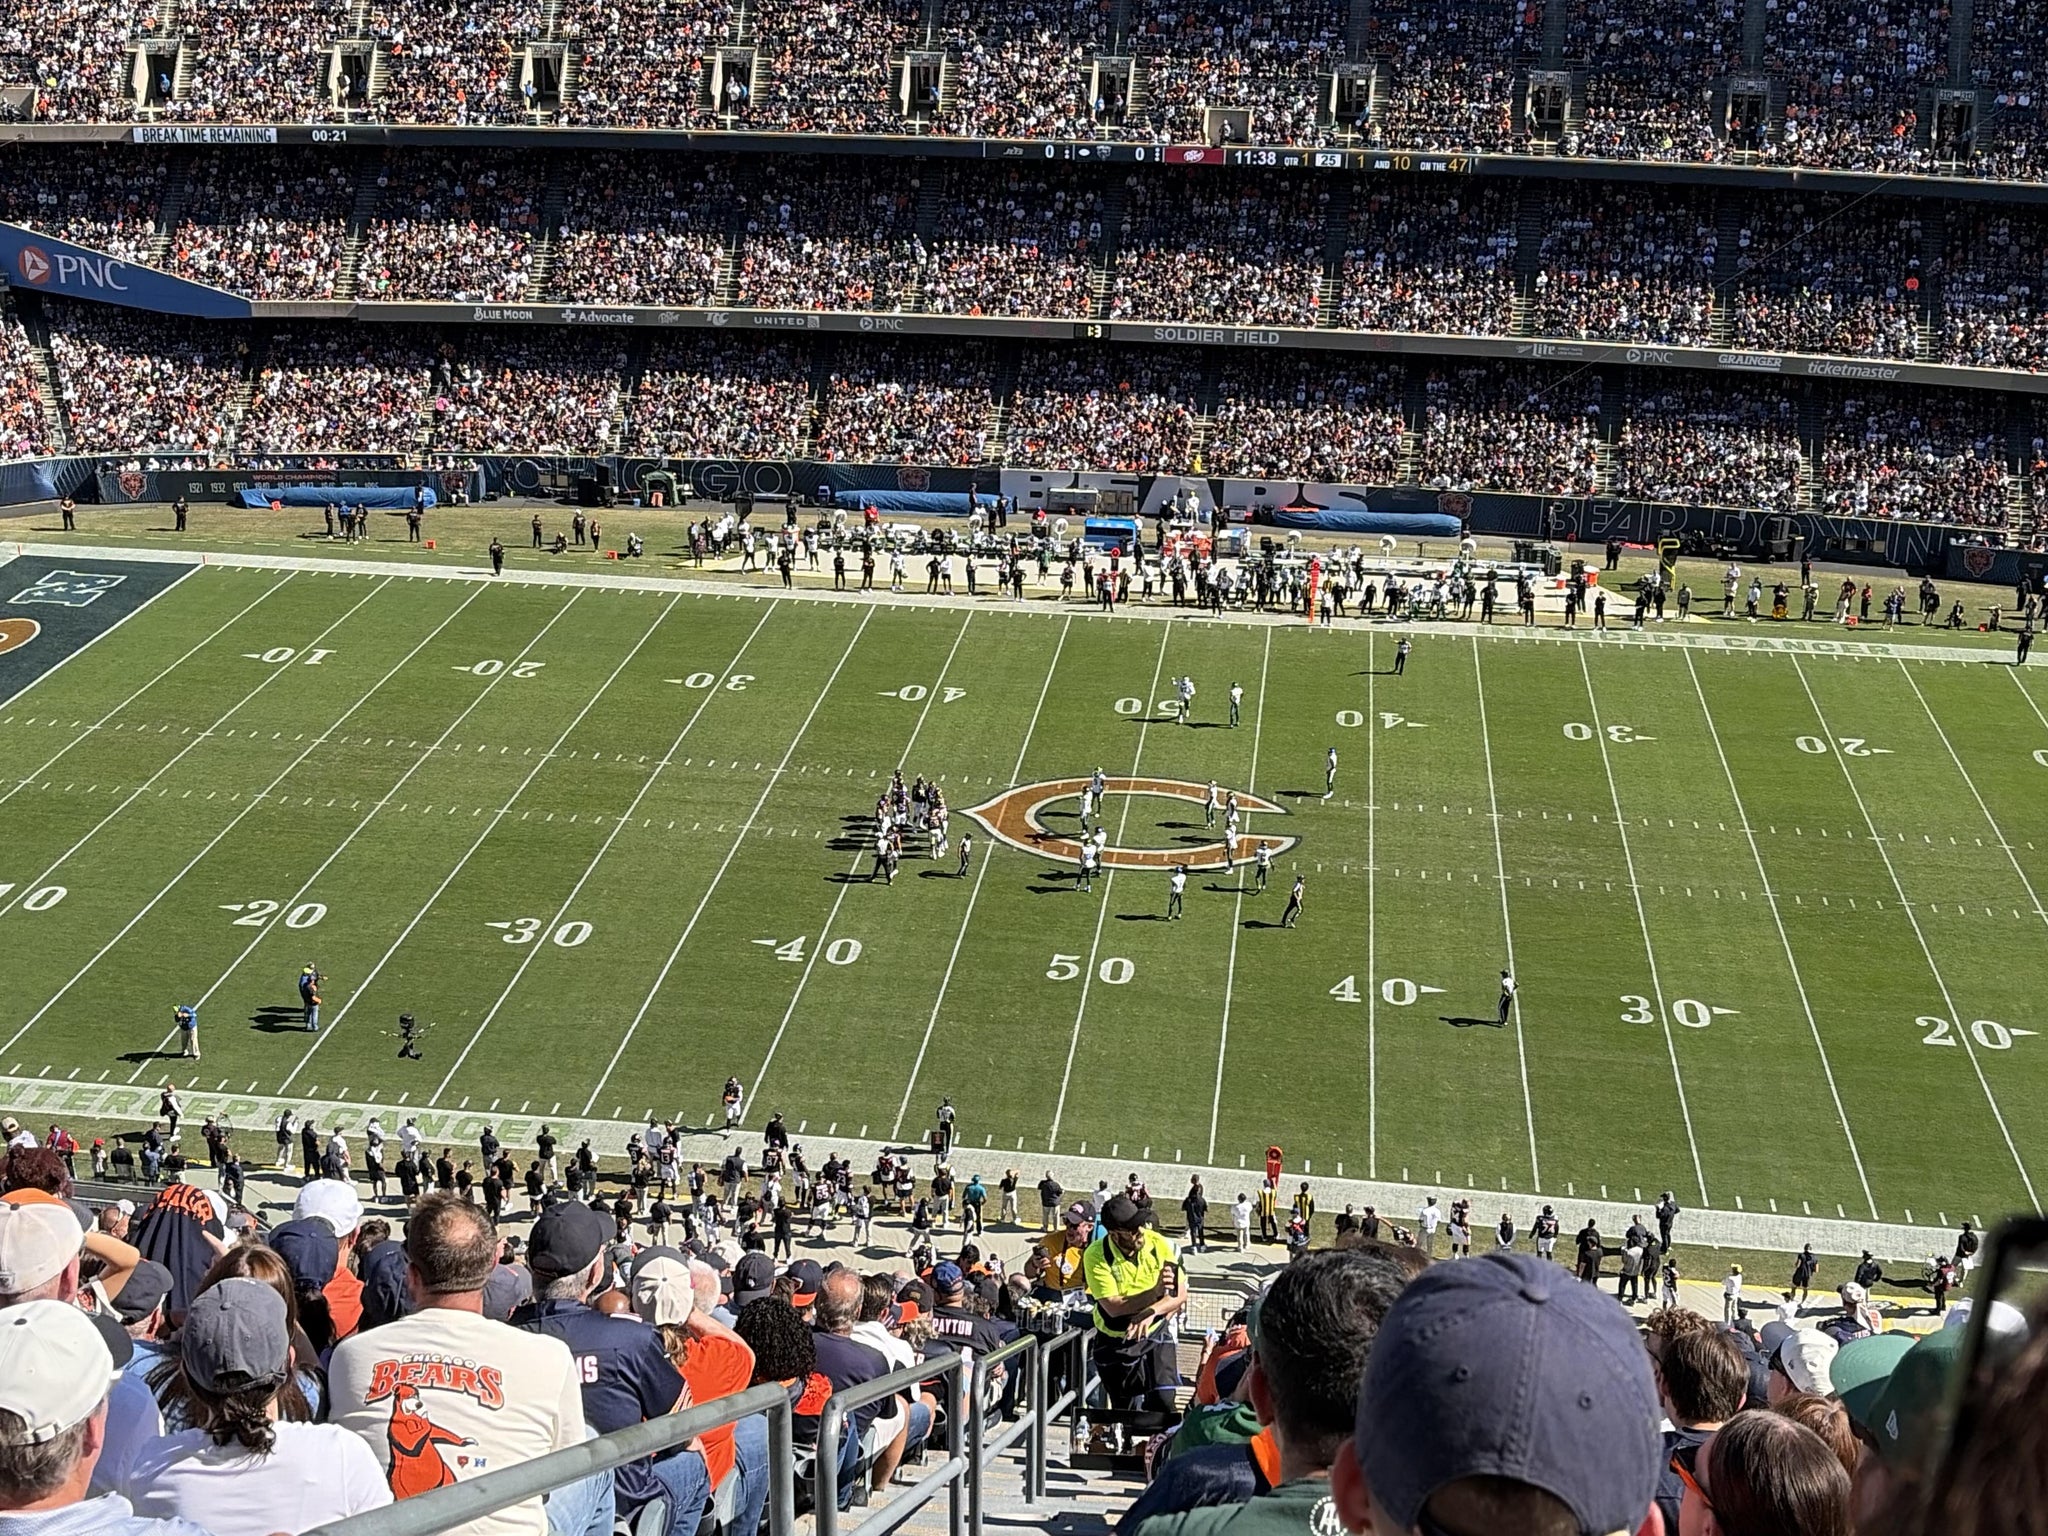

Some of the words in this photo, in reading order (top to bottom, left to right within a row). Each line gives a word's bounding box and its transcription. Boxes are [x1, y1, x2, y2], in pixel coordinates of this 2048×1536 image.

[142, 128, 178, 142] BREAK
[181, 128, 207, 142] TIME
[210, 128, 271, 142] REMAINING
[312, 130, 347, 142] 00:21
[1045, 145, 1054, 158] 0
[1136, 147, 1145, 160] 0
[1235, 150, 1276, 165] 11:38
[1284, 157, 1298, 167] QTR
[1301, 153, 1309, 166] 1
[1321, 155, 1337, 167] 25
[1357, 155, 1364, 168] 1
[1374, 160, 1390, 169] AND
[1393, 156, 1410, 170] 10
[1420, 161, 1430, 171] ON
[1431, 162, 1446, 172] THE
[1448, 158, 1469, 172] 47
[53, 254, 128, 291] PNC
[473, 307, 502, 321] BLUE
[503, 309, 533, 320] MOON
[578, 310, 635, 324] Advocate
[754, 316, 805, 326] UNITED
[875, 318, 904, 330] PNC
[1153, 327, 1224, 343] SOLDIER
[1234, 329, 1280, 345] FIELD
[1532, 344, 1556, 357] Lite
[1643, 351, 1673, 363] PNC
[1718, 354, 1782, 367] GRAINGER
[1807, 361, 1900, 379] ticketmaster
[188, 482, 203, 493] 1921
[210, 482, 226, 493] 1932
[1723, 636, 1890, 656] CANCER
[660, 1153, 671, 1164] 13
[766, 1156, 779, 1167] 87
[836, 1174, 847, 1186] 23
[816, 1189, 829, 1200] 65
[932, 1317, 974, 1337] PAYTON
[402, 1353, 476, 1368] CHICAGO
[364, 1359, 505, 1411] BEARS
